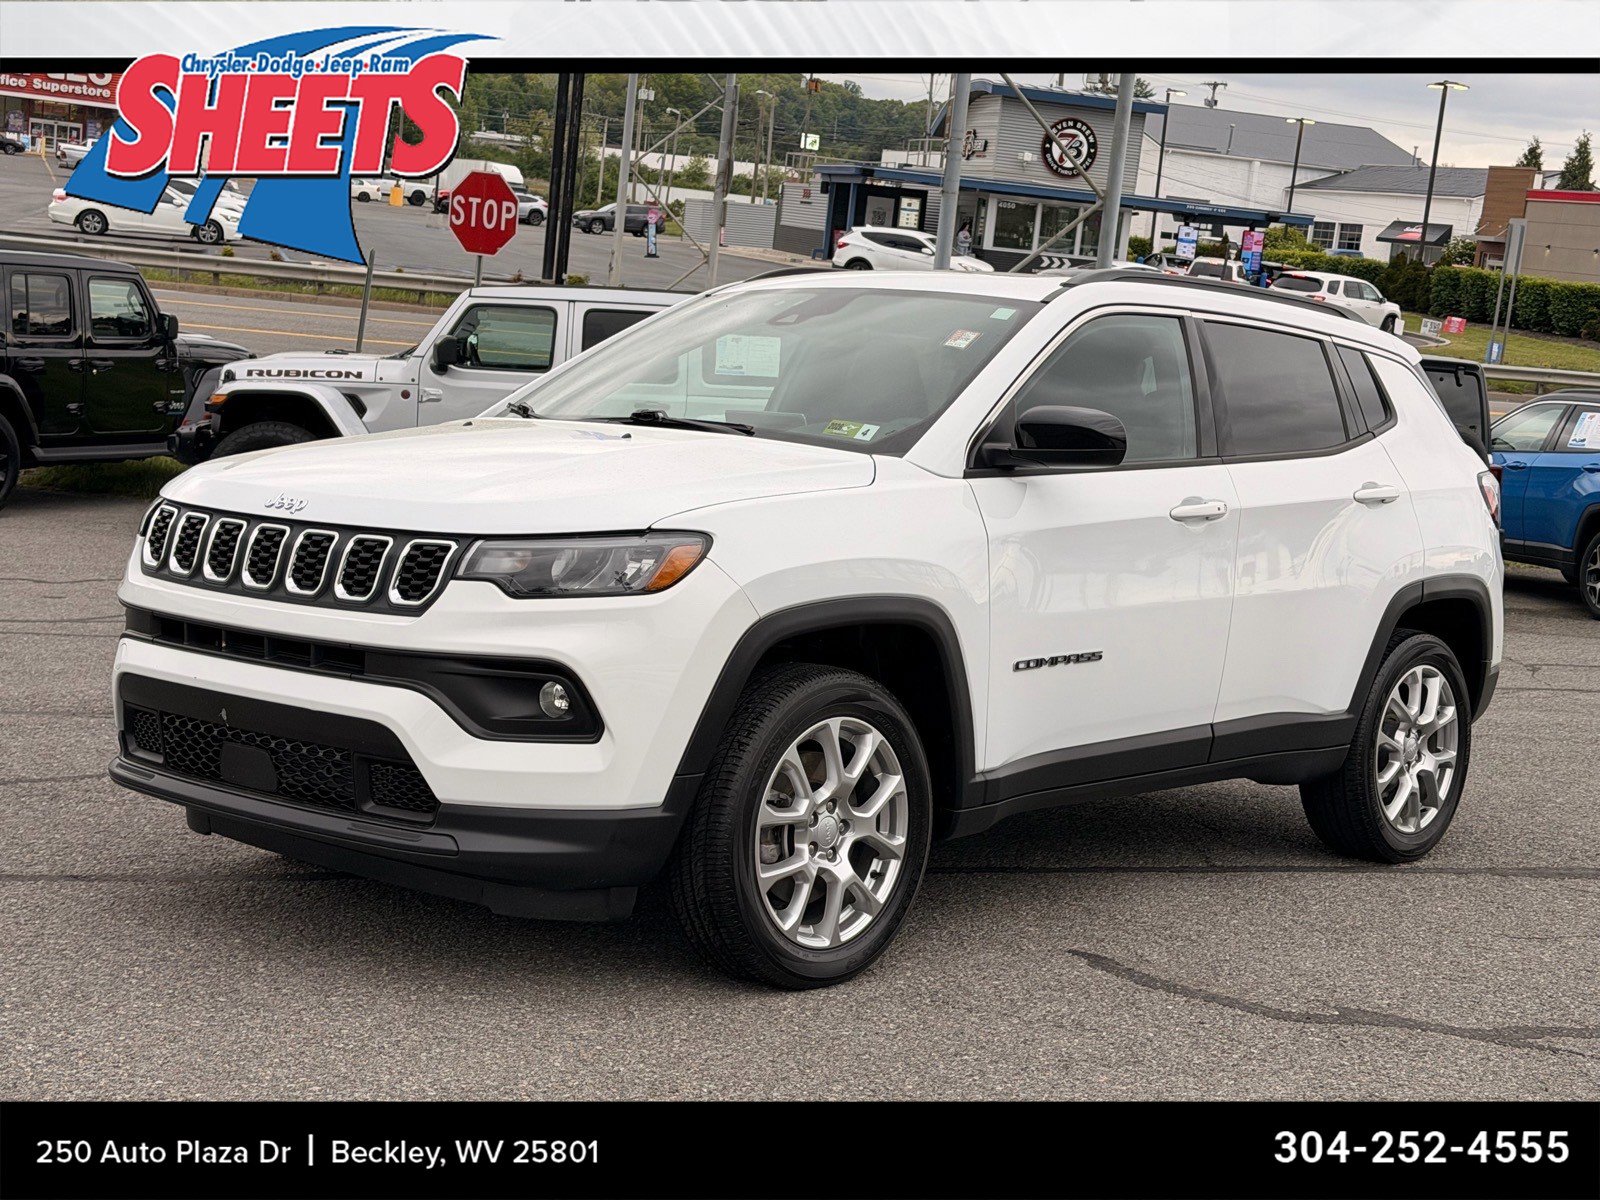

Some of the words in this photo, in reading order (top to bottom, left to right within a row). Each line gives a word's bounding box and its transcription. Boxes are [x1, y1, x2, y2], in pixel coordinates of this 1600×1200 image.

[33, 78, 111, 98] Superstore
[1051, 120, 1074, 135] EVEN
[1076, 122, 1095, 143] BREW
[451, 195, 517, 231] STOP
[246, 368, 363, 379] RUBICON
[264, 489, 309, 515] Jeep
[1013, 651, 1103, 672] COMPASS
